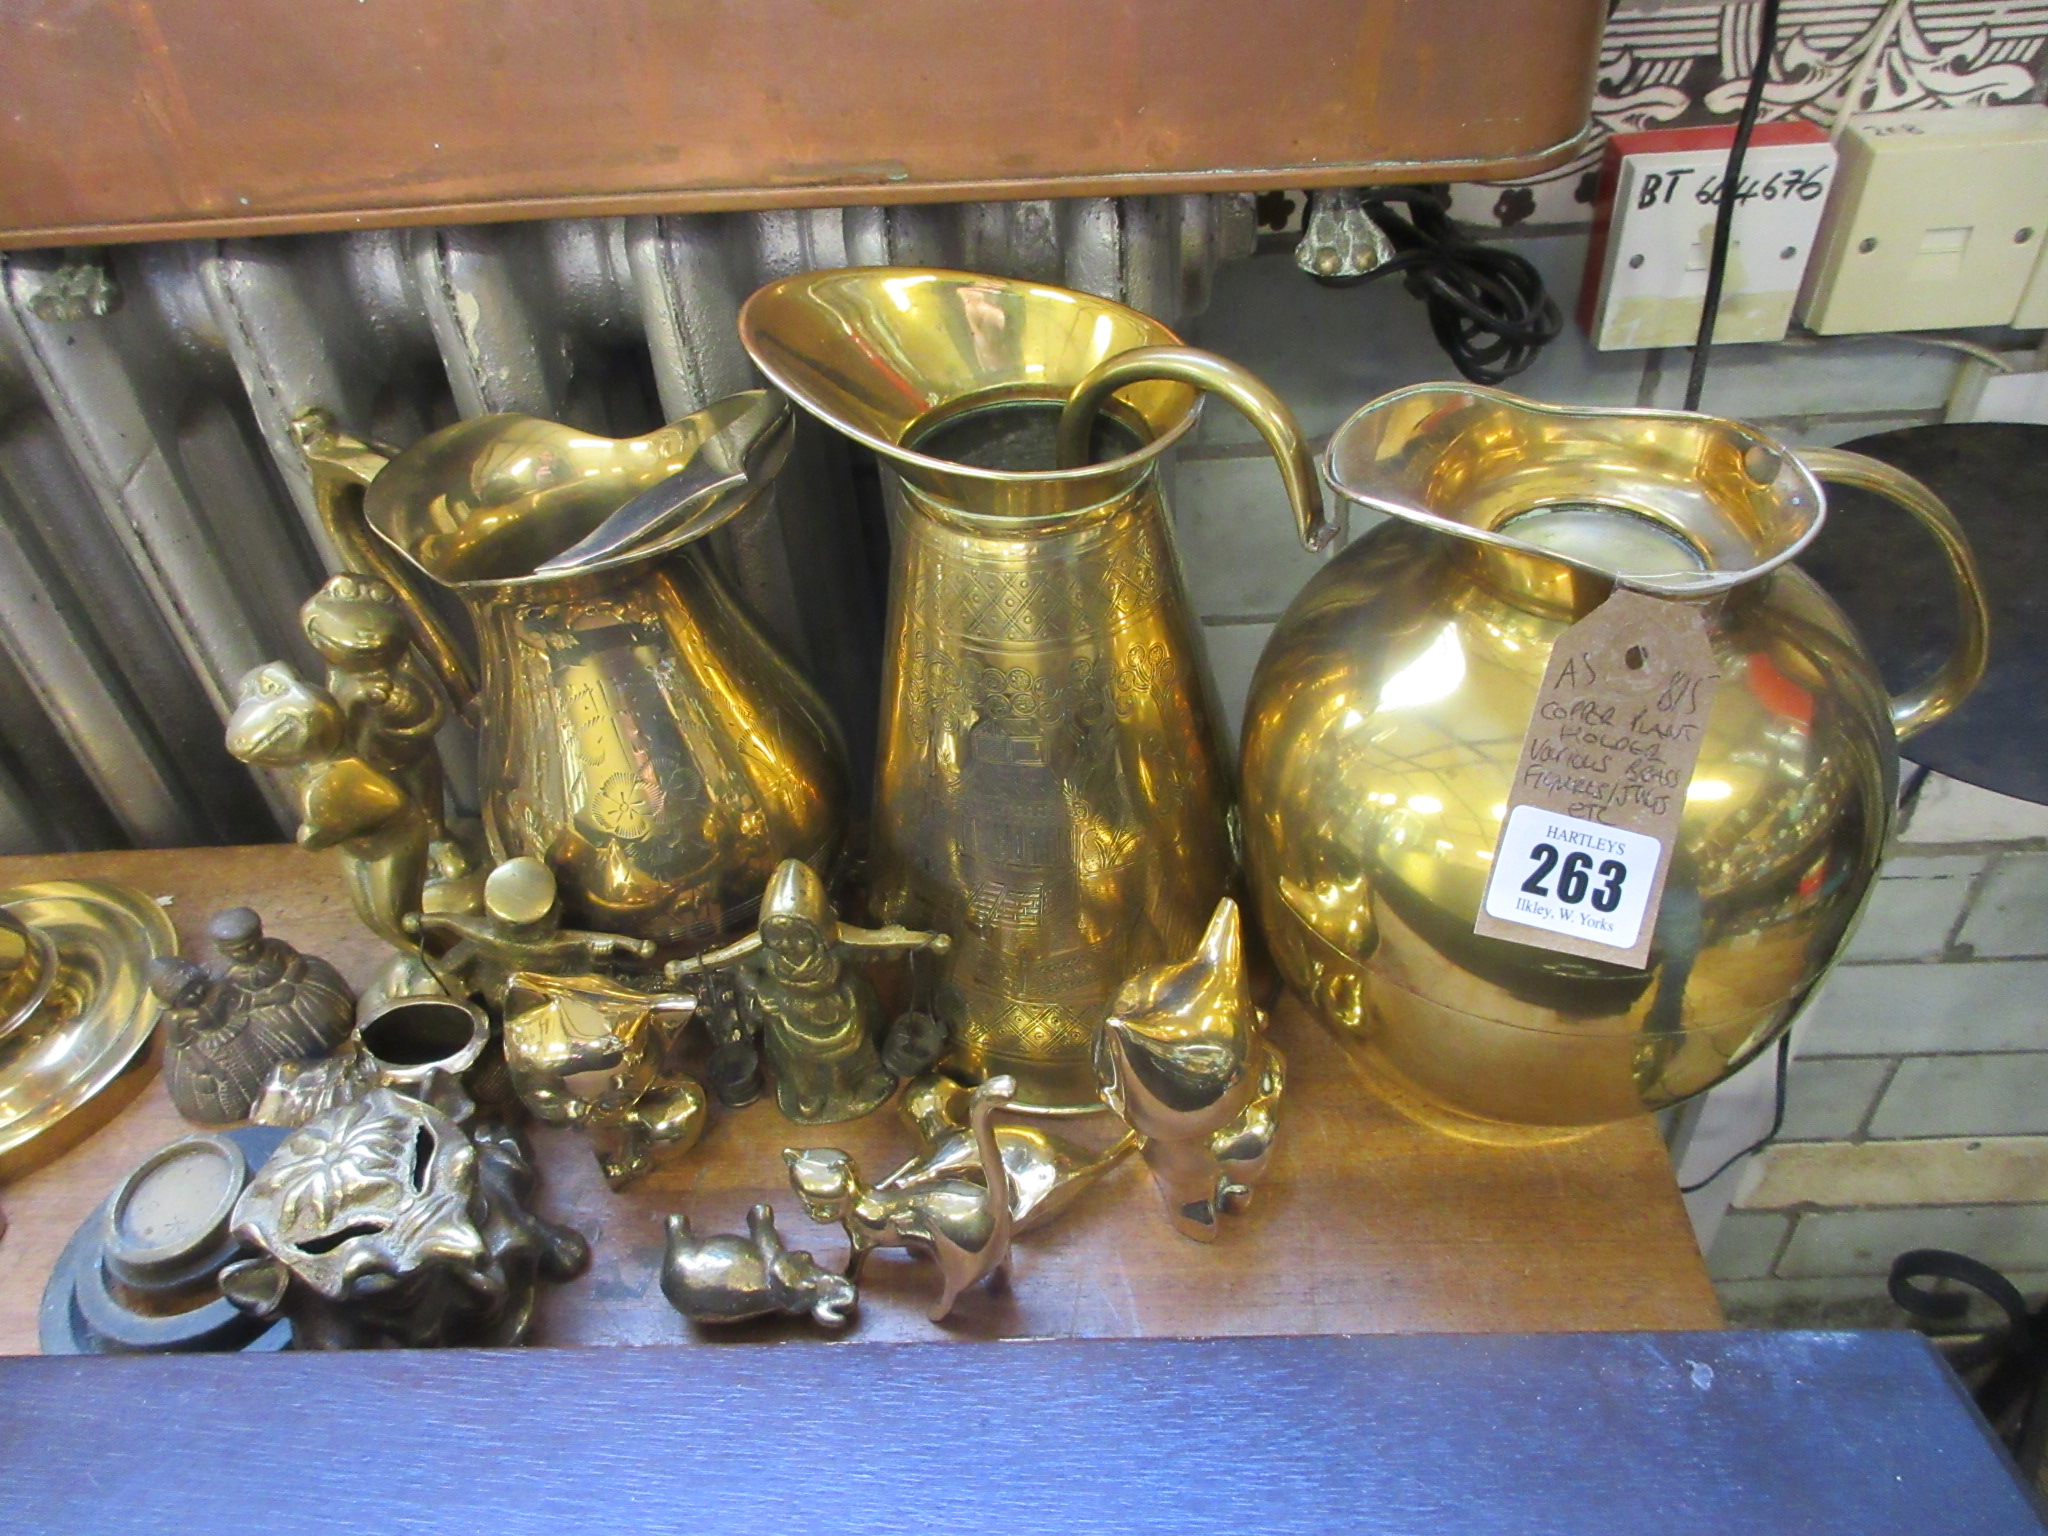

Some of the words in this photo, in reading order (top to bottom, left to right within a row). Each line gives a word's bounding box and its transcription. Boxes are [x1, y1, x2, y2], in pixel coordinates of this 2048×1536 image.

[1638, 168, 1695, 209] BT
[1546, 824, 1626, 857] HARTLEYS
[1520, 842, 1628, 914] 263
[1560, 907, 1575, 924] W.
[1579, 910, 1614, 932] Yorks
